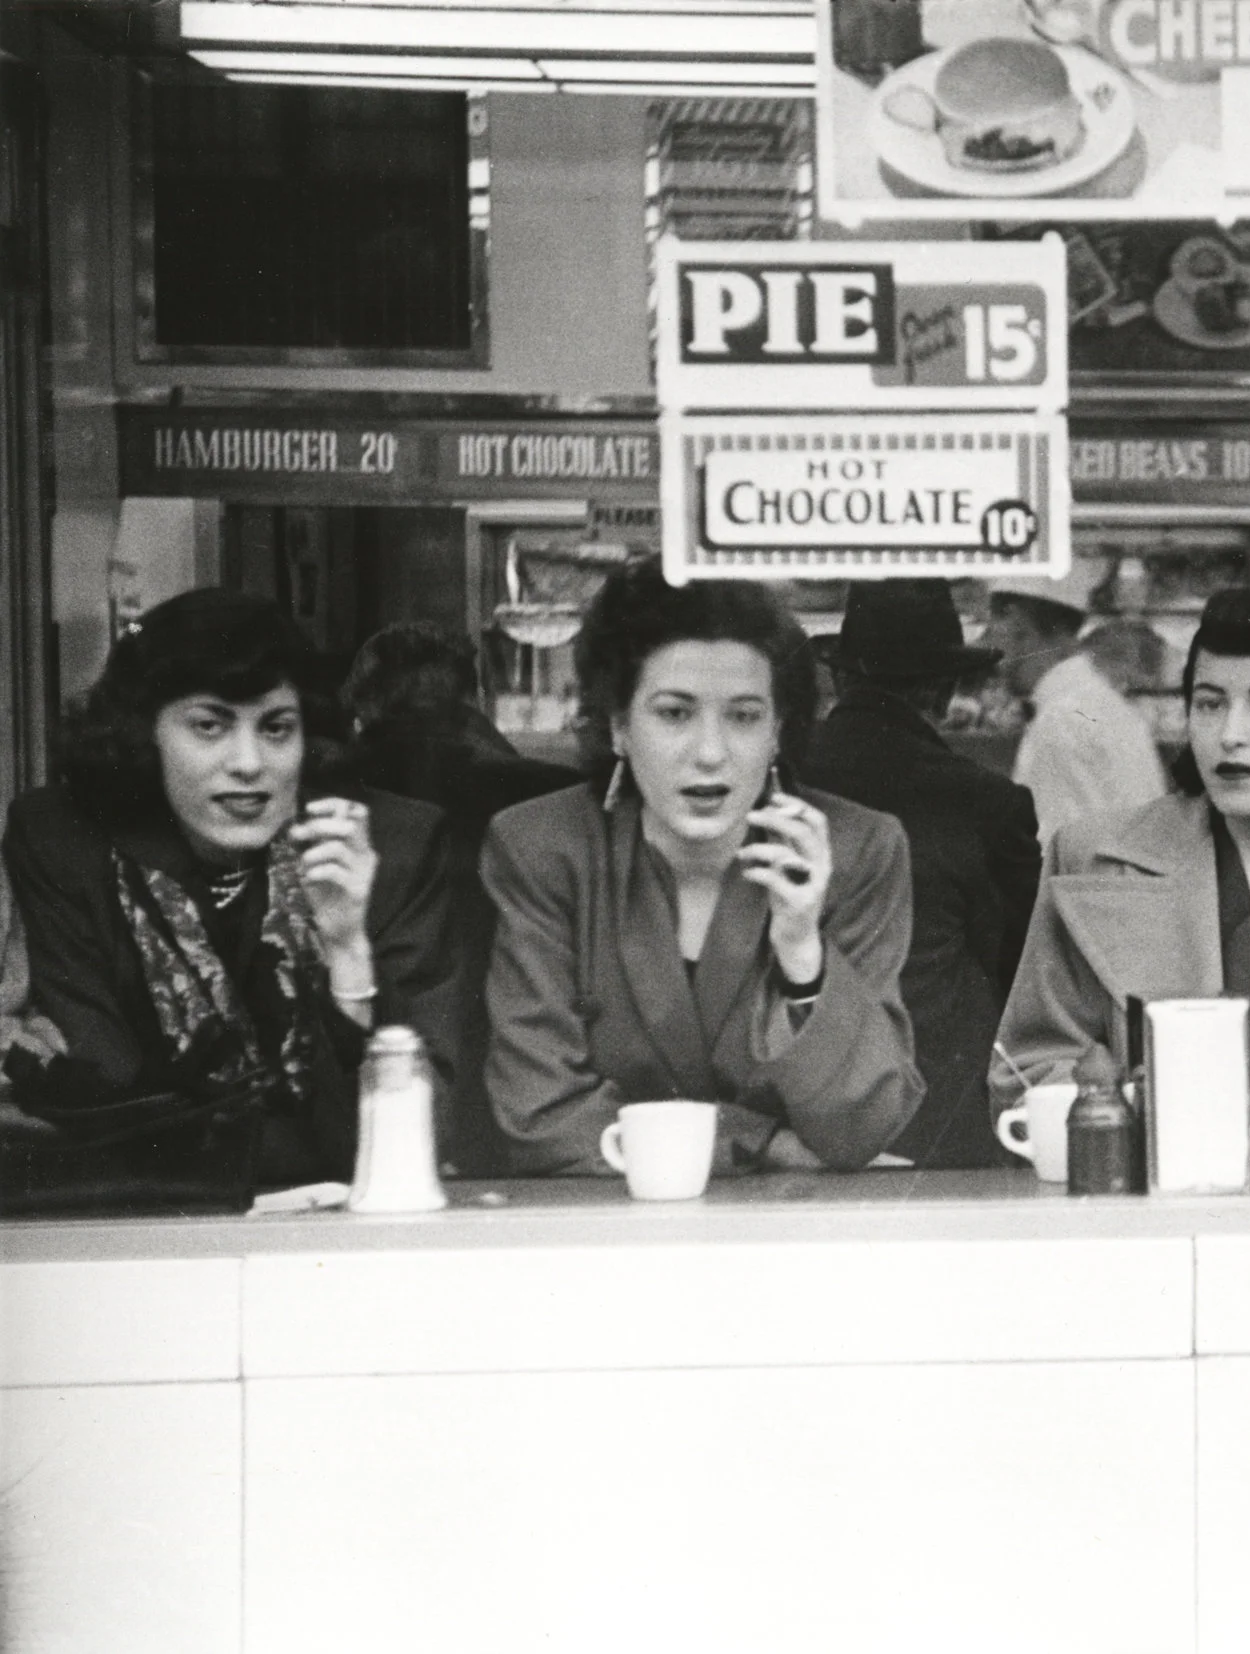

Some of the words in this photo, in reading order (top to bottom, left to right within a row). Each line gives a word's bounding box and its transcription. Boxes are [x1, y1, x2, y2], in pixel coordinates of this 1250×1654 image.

[685, 271, 877, 354] PIE
[155, 429, 337, 472] HAMBURGER
[459, 435, 504, 476] HOT
[512, 435, 650, 478] CHOCOLATE
[807, 460, 888, 480] HOT
[1119, 439, 1208, 481] BEANS
